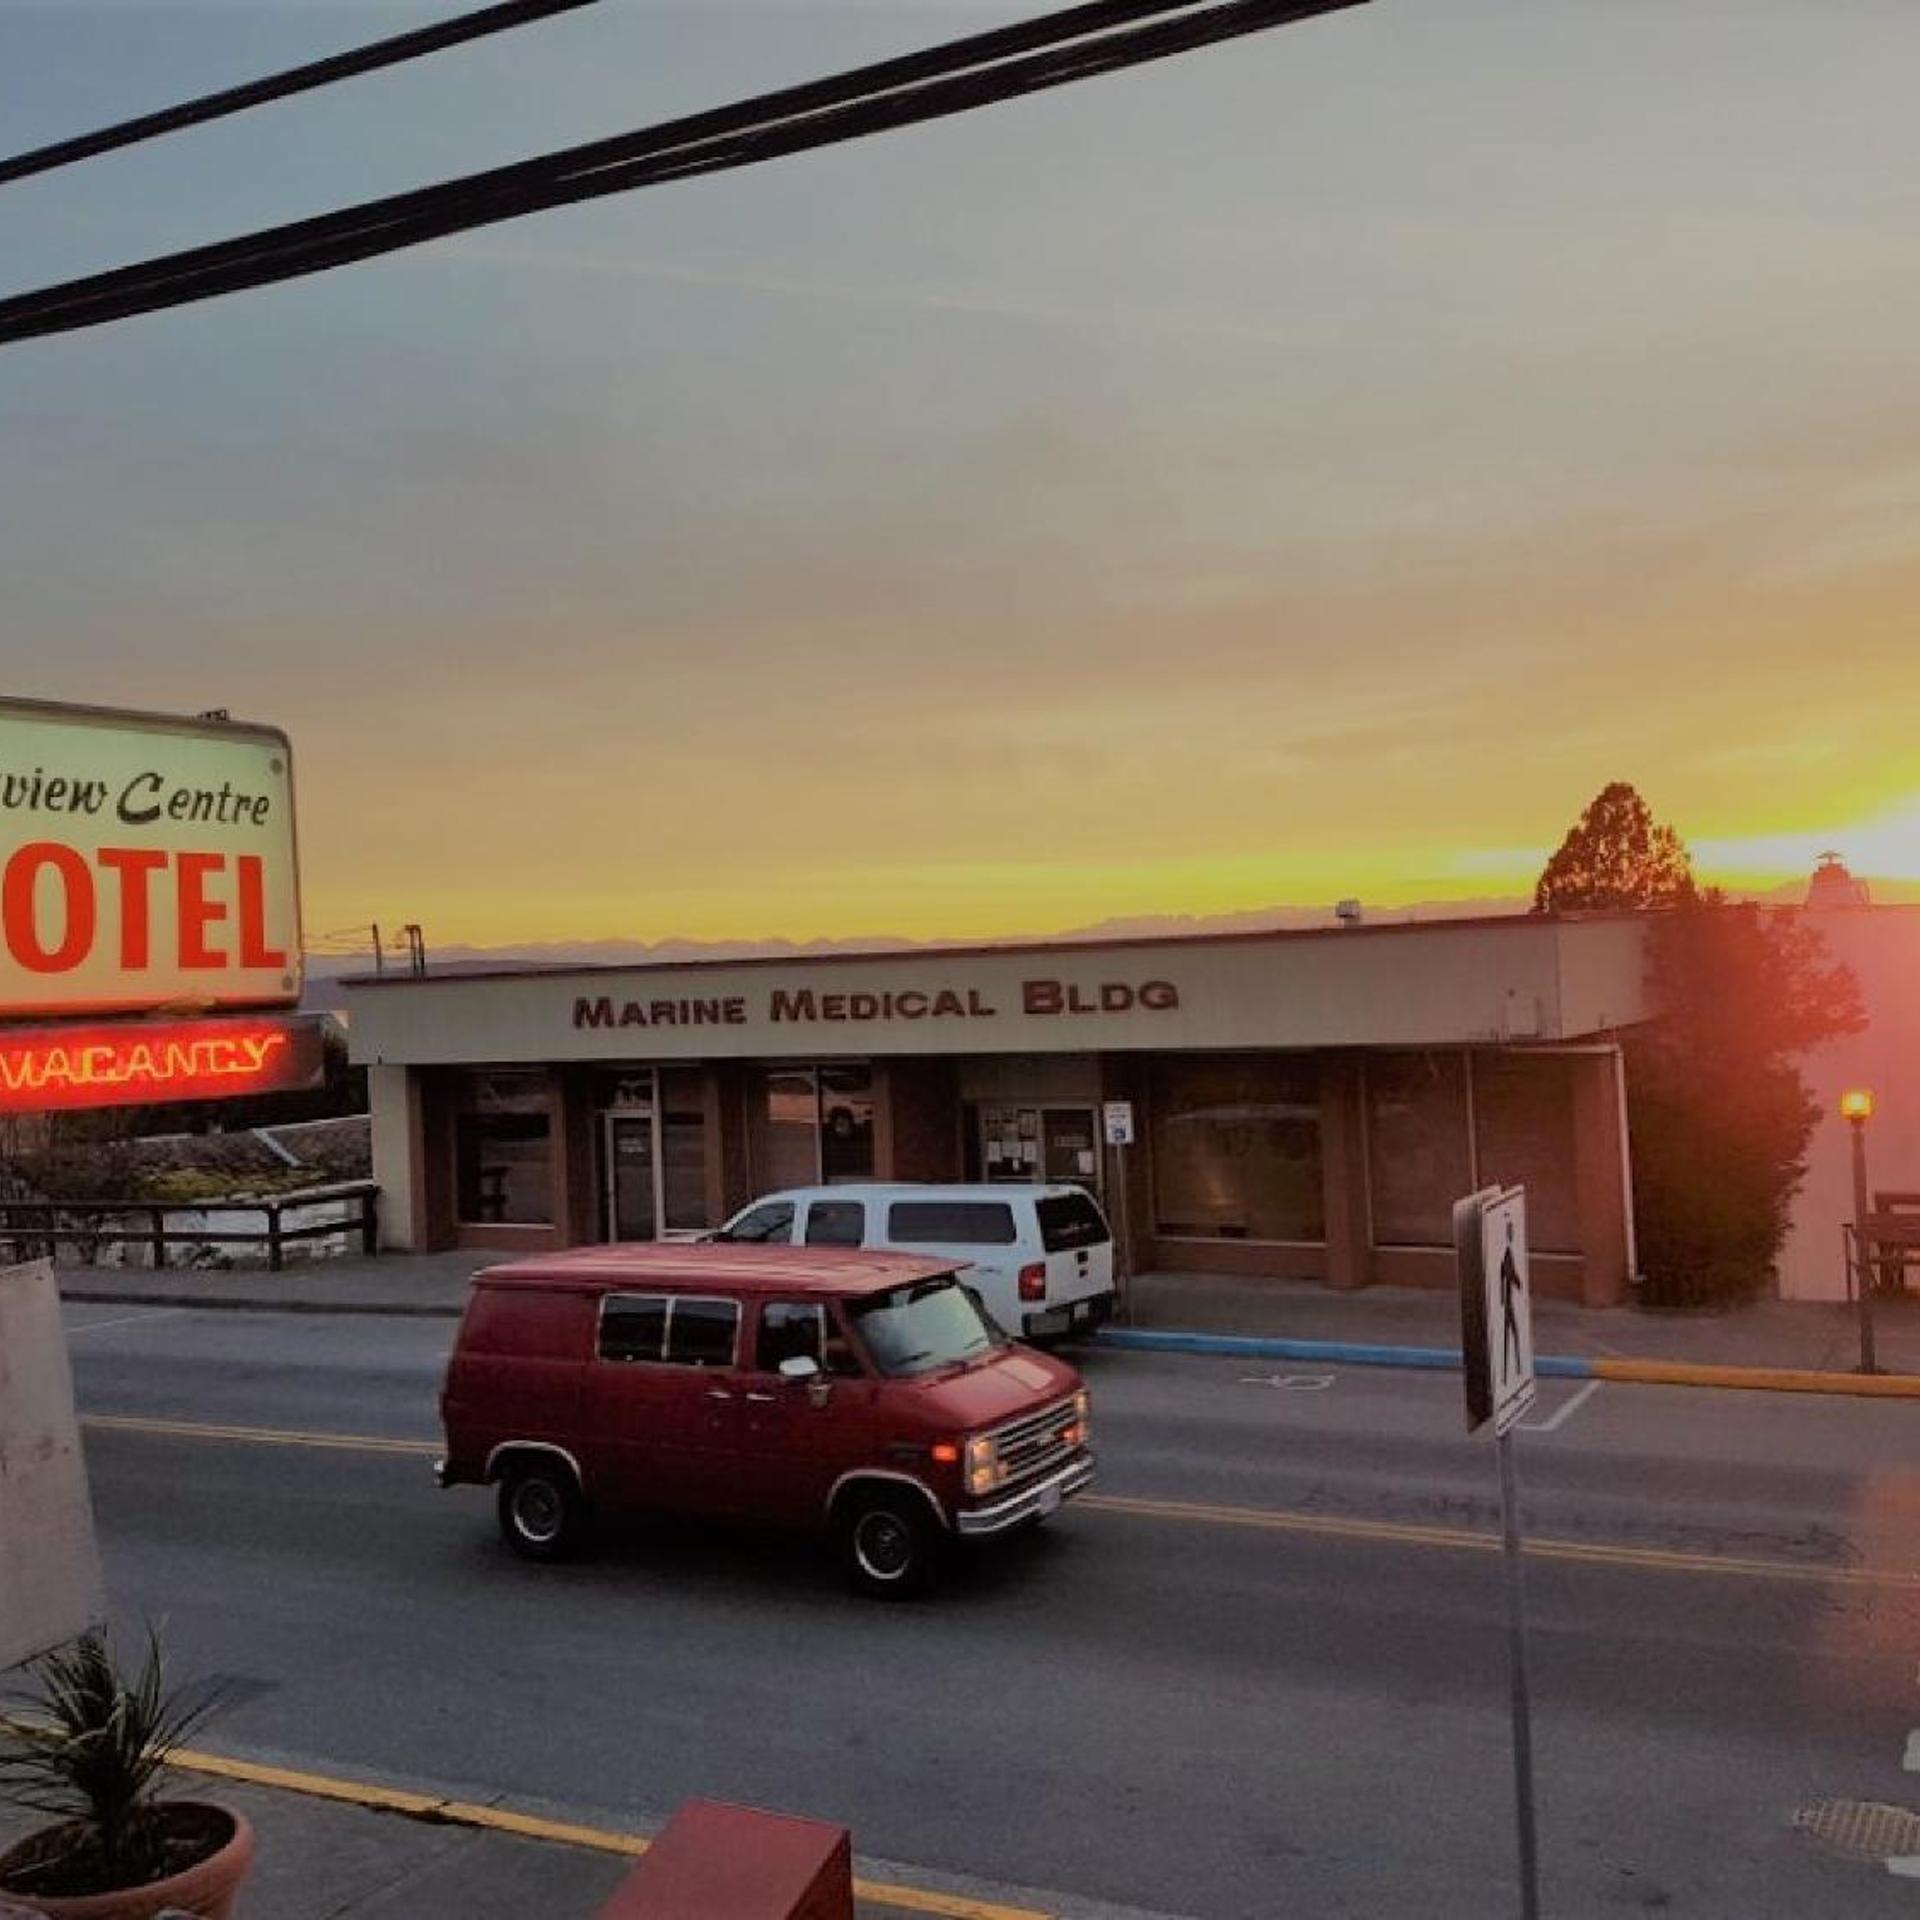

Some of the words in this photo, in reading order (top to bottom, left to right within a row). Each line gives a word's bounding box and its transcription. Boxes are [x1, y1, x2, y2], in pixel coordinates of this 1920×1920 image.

[117, 772, 270, 825] Centre
[2, 842, 286, 973] OTEL
[573, 996, 748, 1029] MARINE
[770, 989, 997, 1022] MEDICAL
[1022, 980, 1180, 1014] BLDG
[0, 1034, 284, 1090] VACANCY
